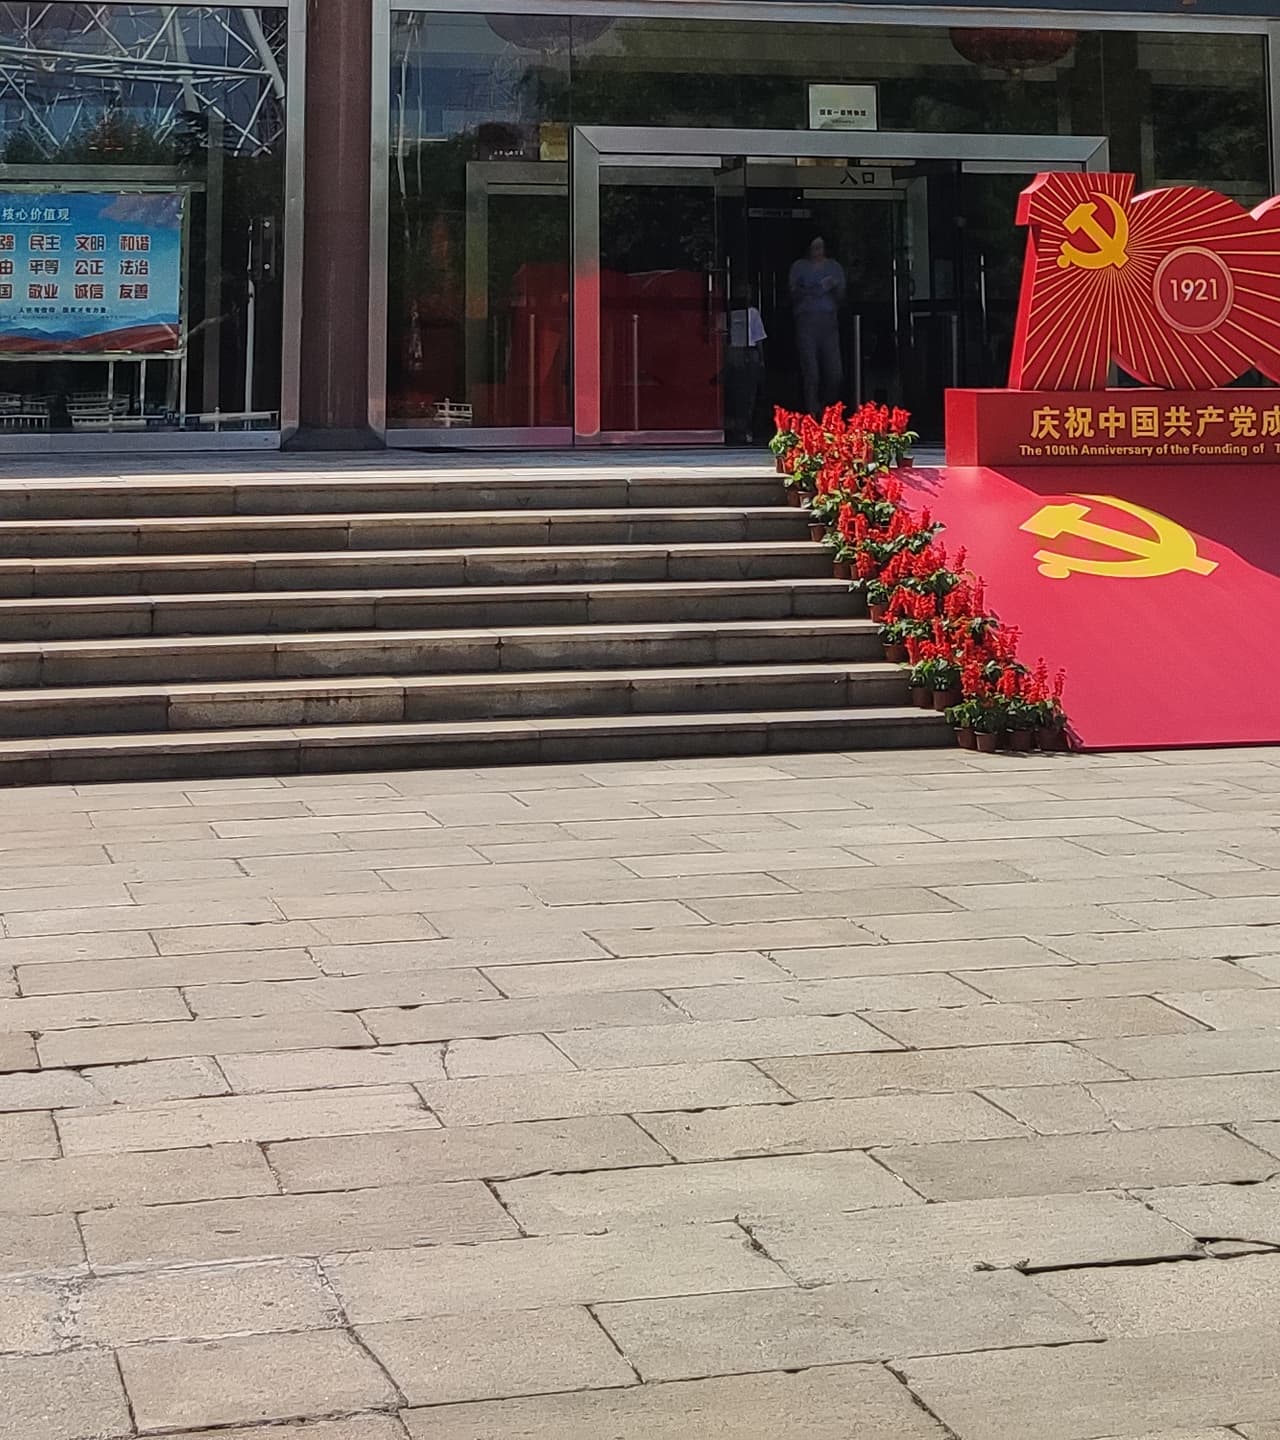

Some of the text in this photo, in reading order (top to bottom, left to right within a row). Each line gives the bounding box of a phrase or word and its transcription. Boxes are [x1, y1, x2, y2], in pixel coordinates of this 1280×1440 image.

[840, 170, 875, 185] 入口
[30, 234, 61, 252] 民主
[75, 234, 107, 252] 文明
[120, 234, 151, 252] 和谐
[29, 259, 60, 276] 平等
[75, 259, 106, 276] 公正
[120, 259, 150, 276] 法治
[28, 283, 59, 300] 敬业
[74, 283, 105, 300] 诚信
[119, 283, 149, 300] 友善
[1170, 278, 1219, 302] 1921
[1020, 444, 1042, 456] The
[1045, 444, 1079, 456] 100th
[1080, 444, 1152, 457] Anniversary
[1155, 443, 1169, 455] of
[1170, 444, 1190, 455] the
[1192, 443, 1248, 456] Founding
[1252, 443, 1265, 453] of
